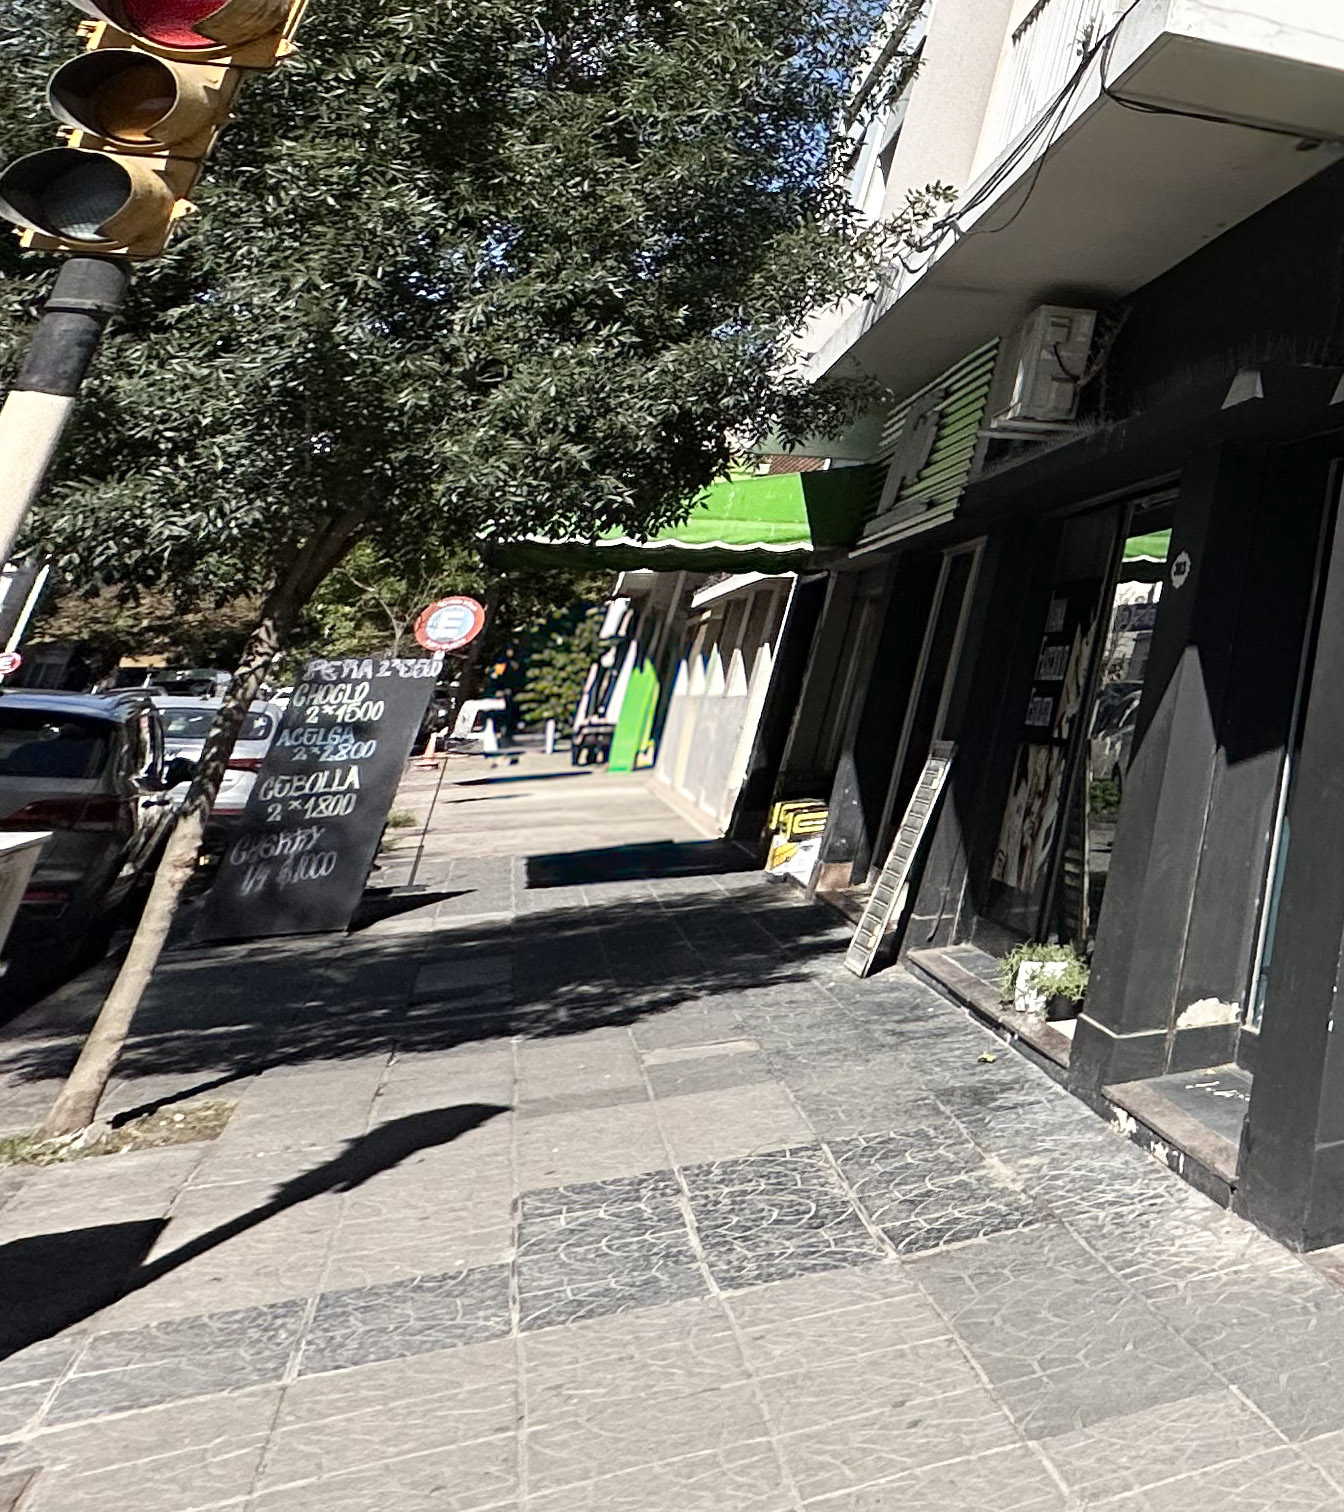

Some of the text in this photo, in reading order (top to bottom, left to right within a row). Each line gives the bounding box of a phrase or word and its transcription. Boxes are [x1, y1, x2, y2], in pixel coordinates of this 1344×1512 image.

[434, 610, 465, 638] E
[302, 658, 373, 681] PERA
[293, 681, 370, 707] CHOCLO
[276, 726, 356, 747] ACELGA
[259, 765, 361, 801] CEBOLLA
